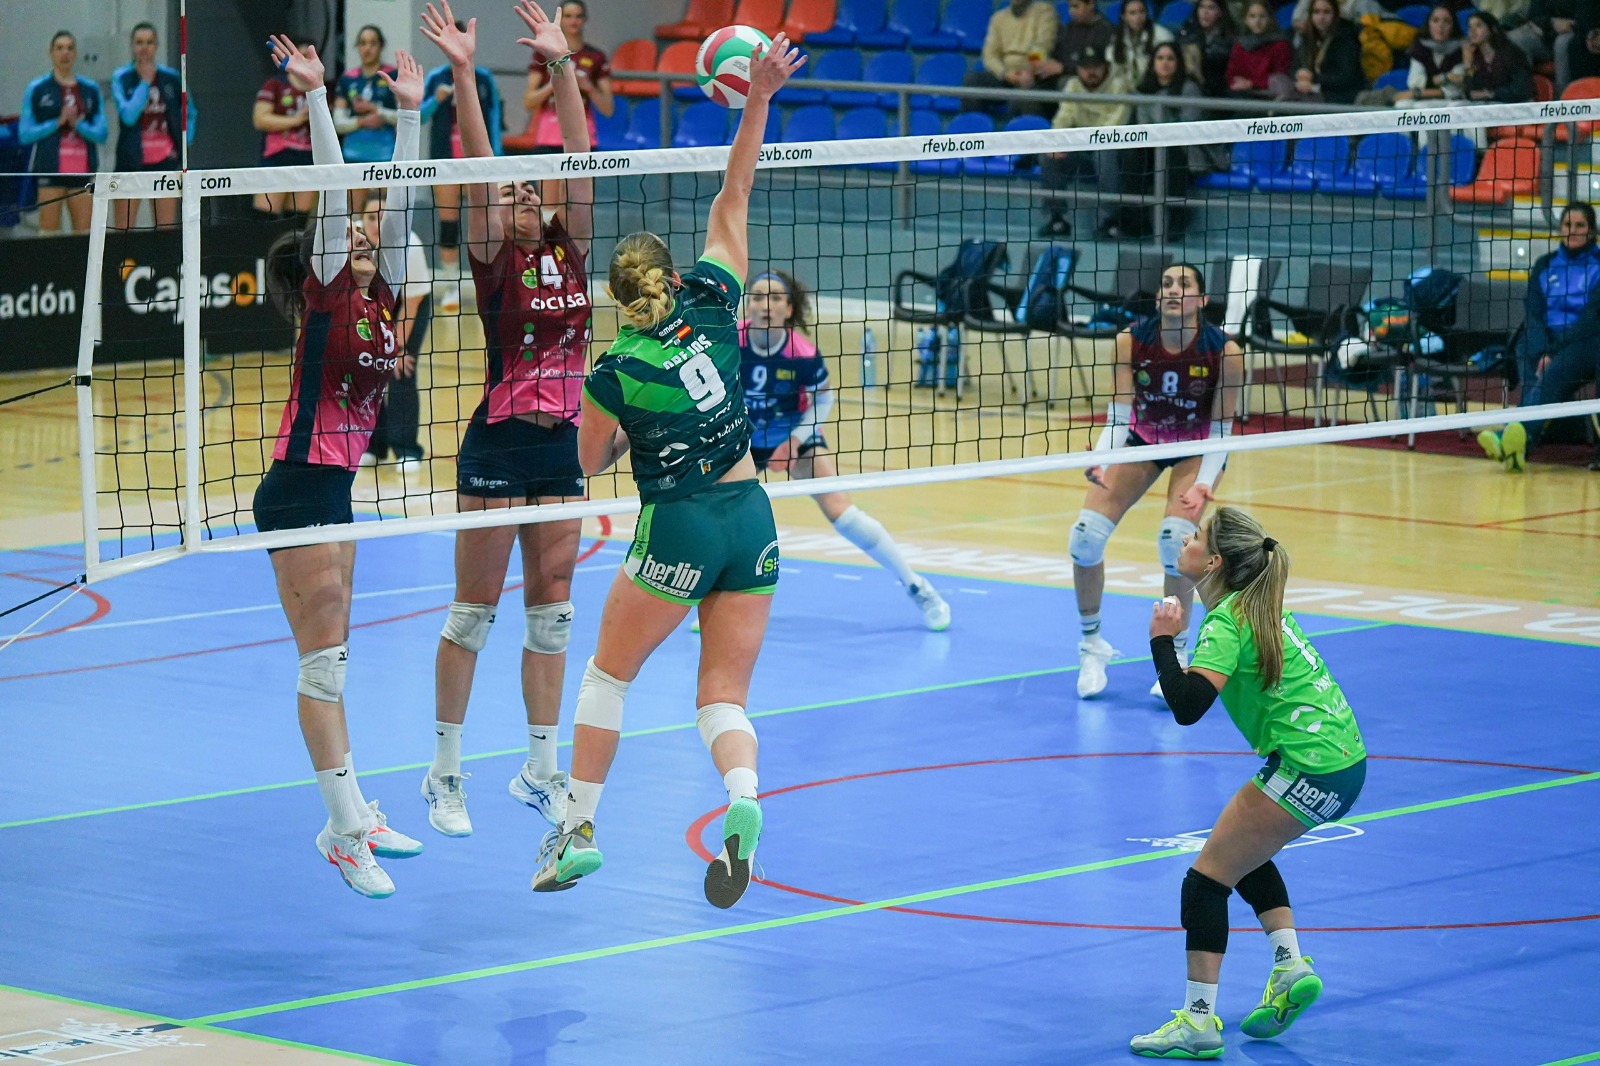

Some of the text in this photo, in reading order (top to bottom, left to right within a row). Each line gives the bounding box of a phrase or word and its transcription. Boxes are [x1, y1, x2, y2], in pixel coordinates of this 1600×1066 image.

[1397, 112, 1450, 126] rfevb.com
[1540, 103, 1591, 118] rfevb.com
[1089, 129, 1148, 144] rfevb.com
[1247, 120, 1303, 135] rfevb.com
[758, 146, 812, 161] evb.com
[922, 138, 985, 153] rfevb.com
[363, 163, 437, 181] rfevb.com
[560, 155, 630, 171] rfevb.com
[540, 255, 563, 290] 4
[530, 292, 588, 311] ocisa
[379, 320, 395, 355] 5
[678, 352, 727, 412] 9
[751, 365, 768, 391] 9
[1161, 371, 1178, 395] 8
[641, 553, 702, 592] berlin
[1290, 777, 1342, 820] berlin
